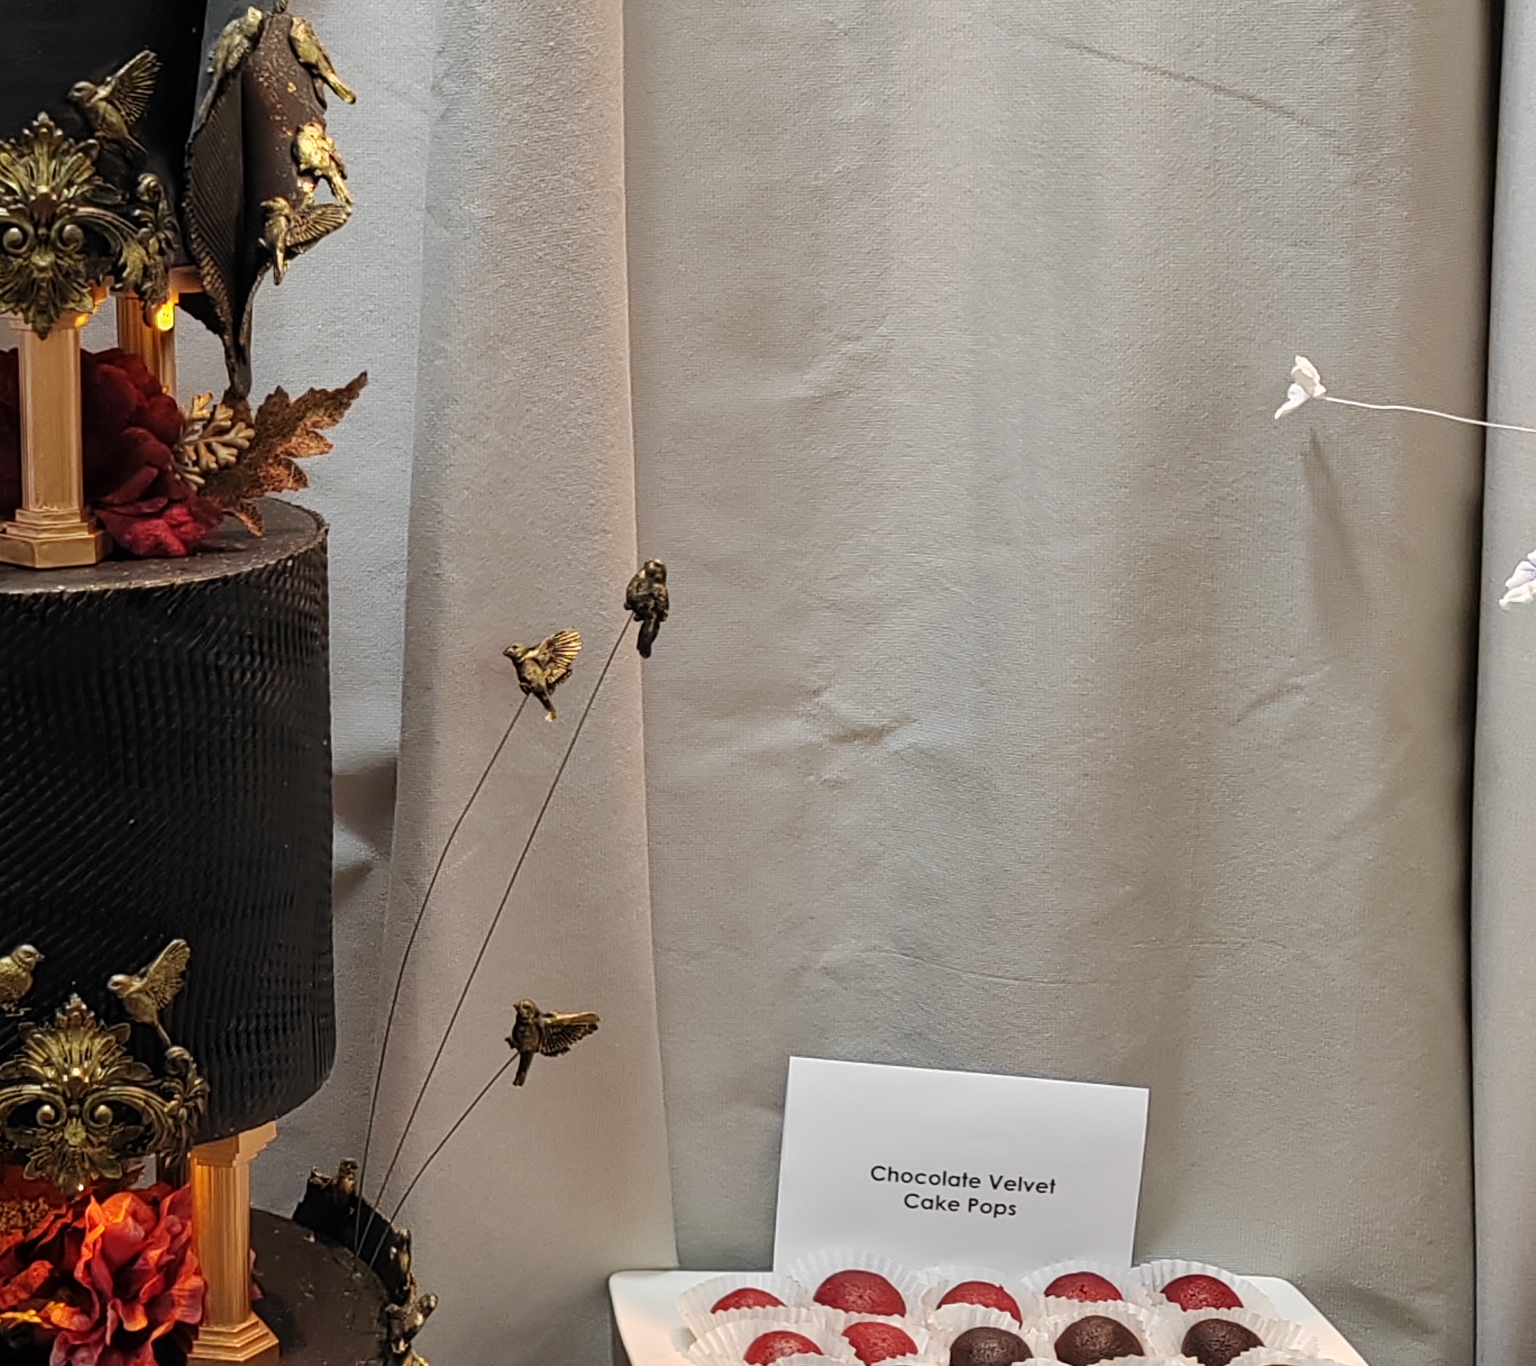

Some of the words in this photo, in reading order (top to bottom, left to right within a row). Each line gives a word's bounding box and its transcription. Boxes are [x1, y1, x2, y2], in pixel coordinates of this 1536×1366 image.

[869, 1164, 981, 1189] Chocolate
[989, 1174, 1057, 1195] Velvet
[903, 1192, 961, 1213] Cake
[967, 1198, 1017, 1219] Pops
